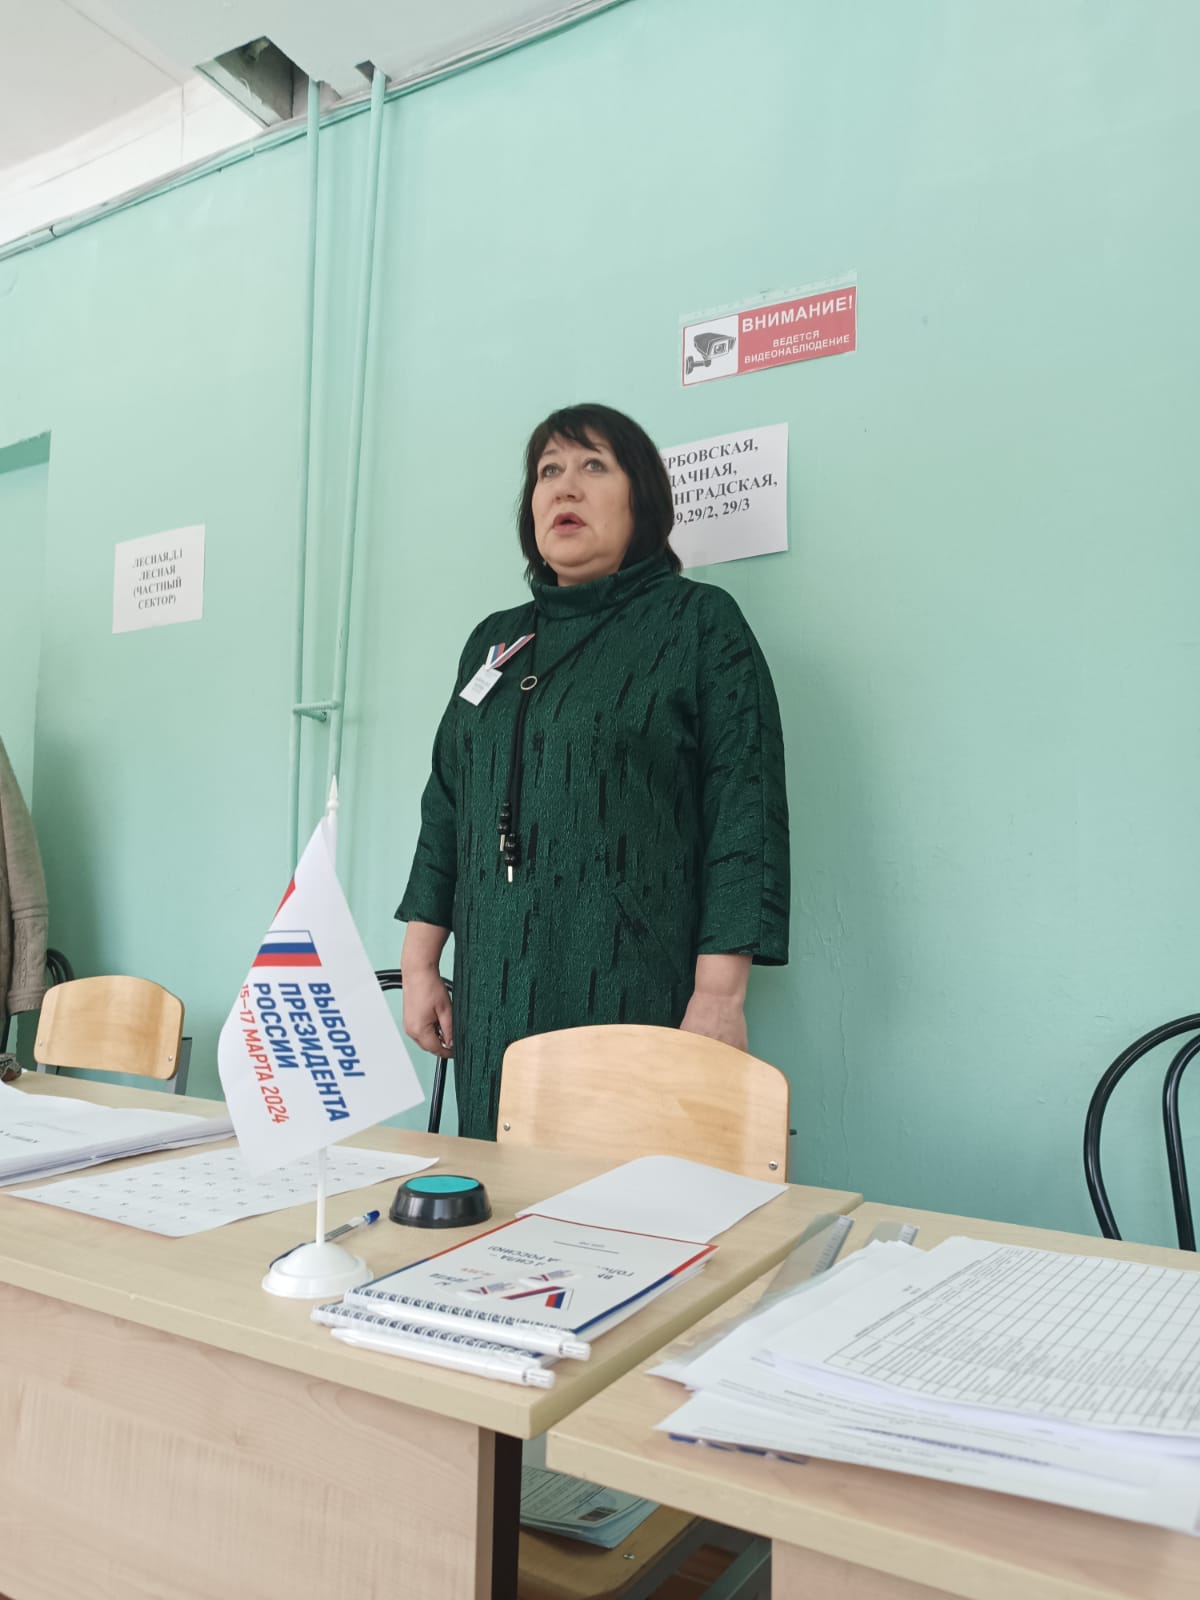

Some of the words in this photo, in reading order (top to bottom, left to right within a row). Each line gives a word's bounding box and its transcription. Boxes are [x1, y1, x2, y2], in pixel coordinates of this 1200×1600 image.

[742, 295, 853, 332] ВНИМАНИЕ!
[744, 335, 850, 364] ВИДЕОНАБЛЮДЕНИЕ
[772, 330, 820, 348] ВЕДЕТСЯ
[664, 438, 759, 470] РБОВСКАЯ,
[674, 473, 778, 506] НГРАДСКАЯ,
[675, 505, 718, 526] 9,29/2,
[723, 498, 750, 515] 29/3
[133, 576, 182, 598] (ЧАСТНЫЙ
[138, 565, 176, 581] ЛЕСНАЯ
[138, 594, 176, 610] СЕКТОР)
[253, 983, 299, 1068] РОССИИ
[308, 983, 366, 1077] ВЫБОРЫ
[278, 983, 350, 1121] ПРЕЗИДЕНТА
[242, 1028, 274, 1082] МАРТА
[260, 1085, 290, 1124] 2024
